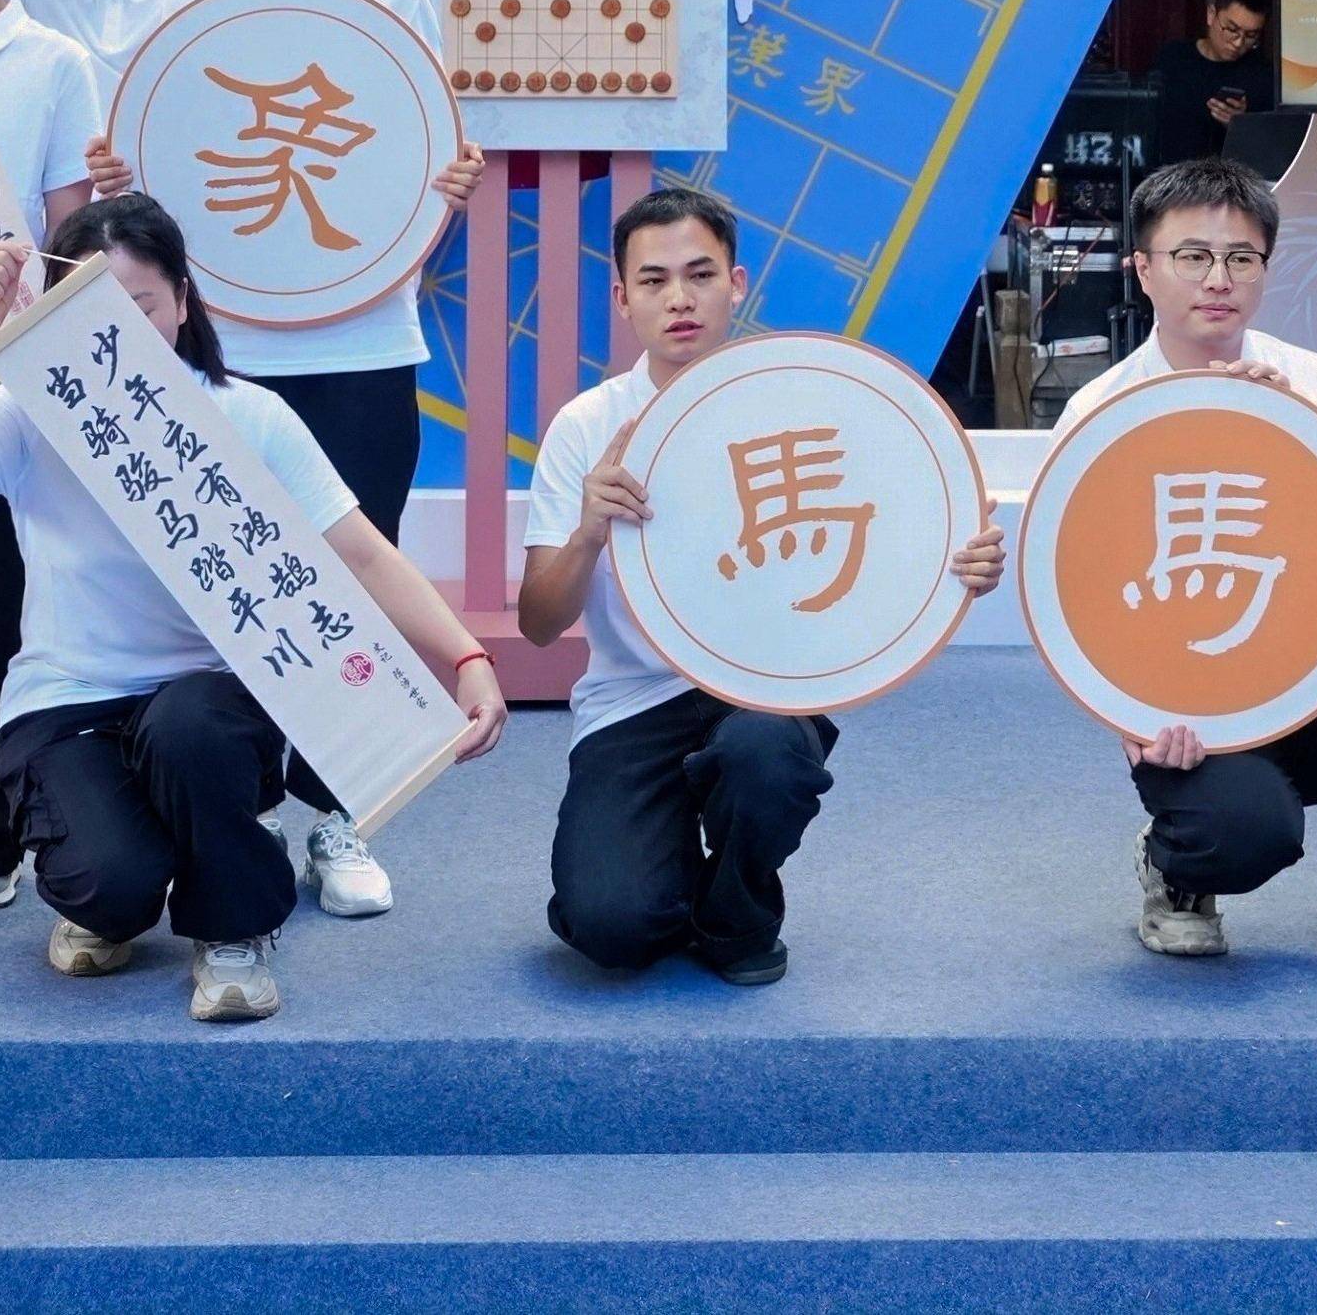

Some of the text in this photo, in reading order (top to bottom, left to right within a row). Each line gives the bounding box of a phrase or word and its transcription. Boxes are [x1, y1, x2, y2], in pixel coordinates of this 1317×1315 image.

[194, 61, 378, 250] 象
[46, 365, 313, 678] 当骑骏马踏平川
[91, 324, 355, 650] 少年应有鸿鹄志
[717, 428, 877, 613] 馬
[1122, 470, 1288, 656] 馬
